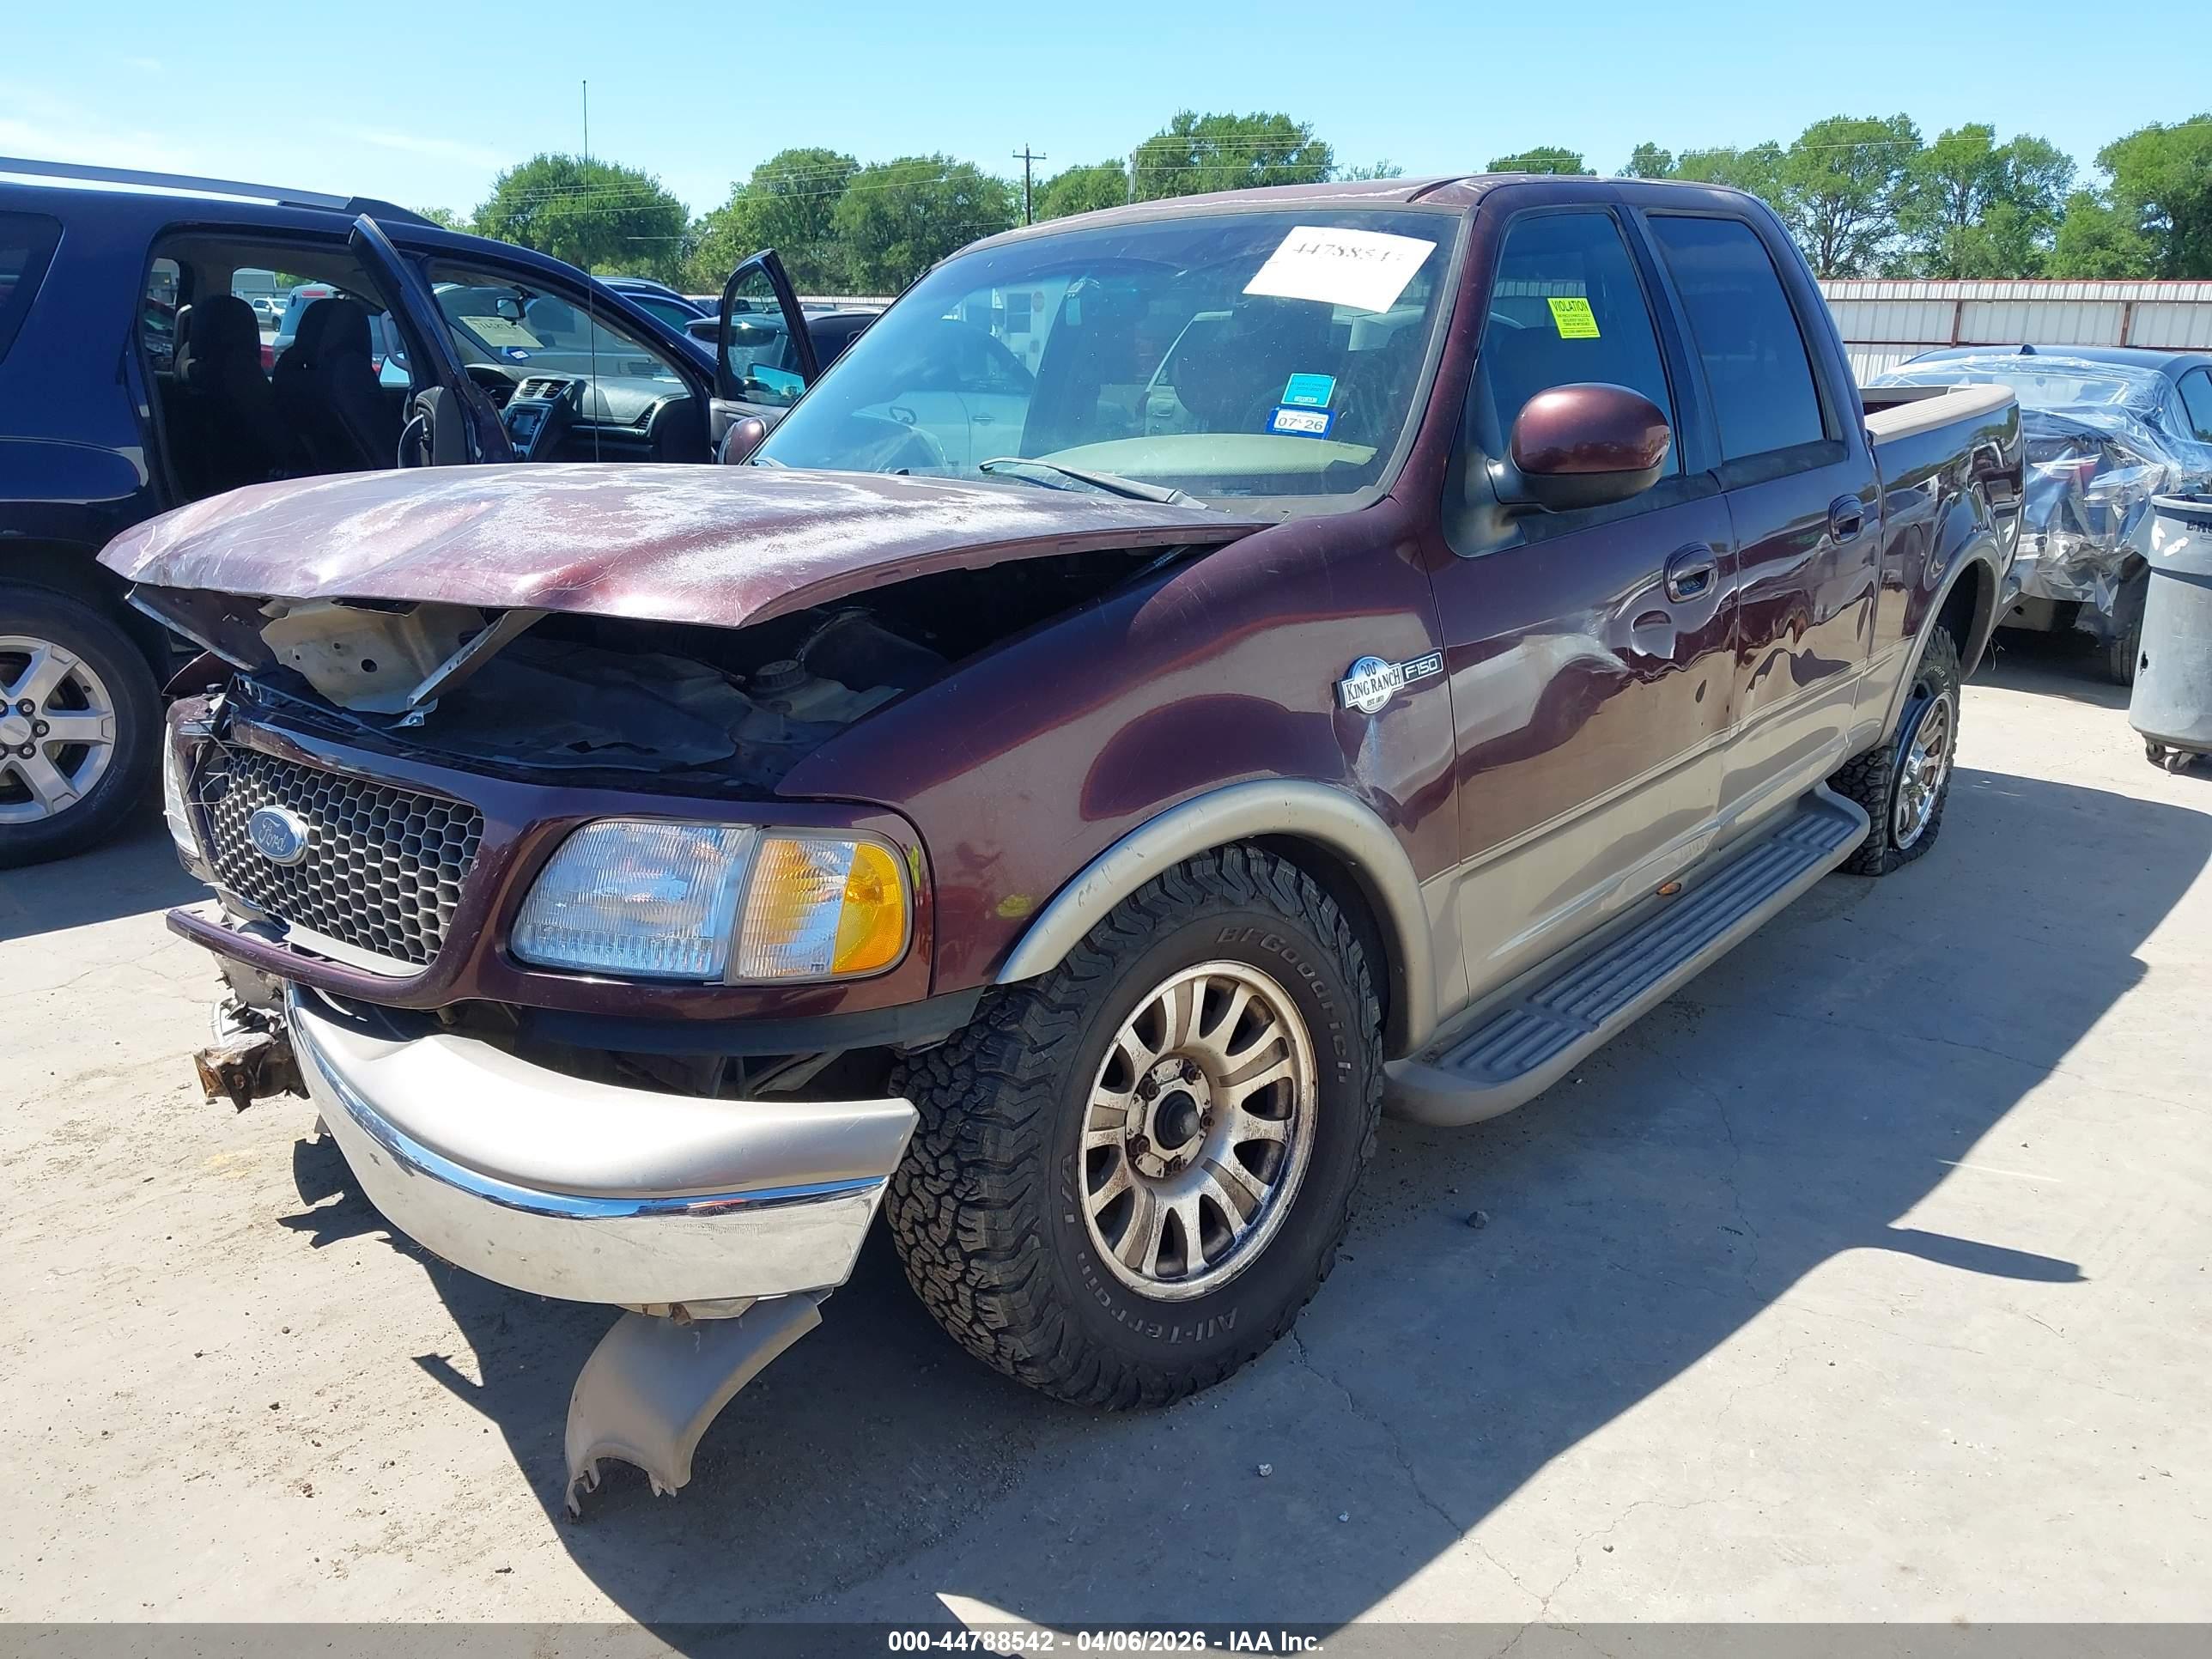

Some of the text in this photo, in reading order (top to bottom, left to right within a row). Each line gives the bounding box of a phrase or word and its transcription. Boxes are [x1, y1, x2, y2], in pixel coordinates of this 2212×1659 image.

[1551, 301, 1589, 312] VIOLATION
[1278, 417, 1297, 428] 07
[1304, 419, 1323, 431] 26
[1346, 668, 1401, 702] KING RANCH
[258, 817, 288, 852] Ford
[1077, 1252, 1237, 1343] All-Terrain
